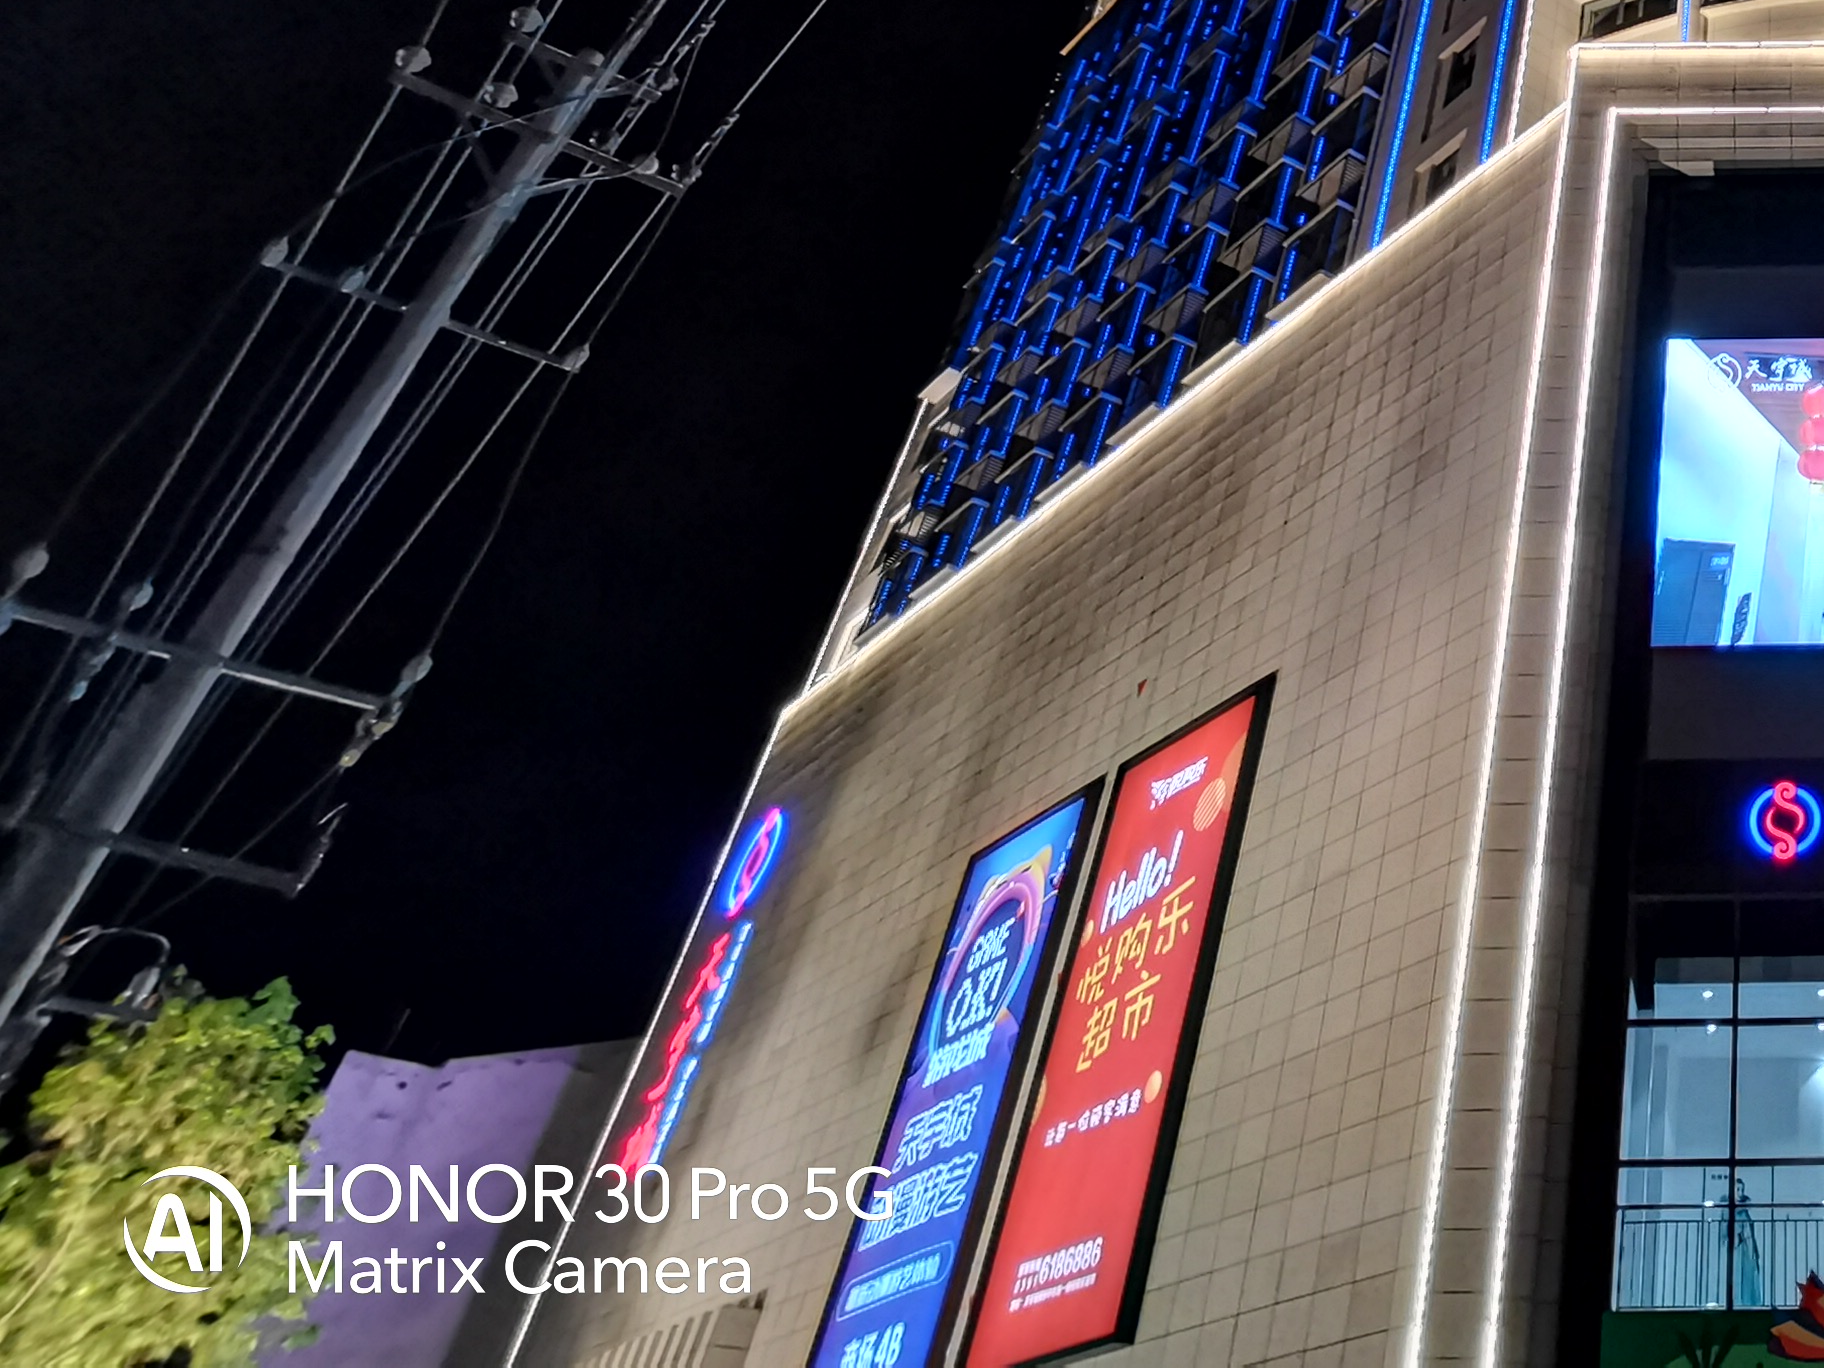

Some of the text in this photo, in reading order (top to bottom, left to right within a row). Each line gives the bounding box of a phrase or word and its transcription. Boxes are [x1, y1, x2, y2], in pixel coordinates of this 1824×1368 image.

[1100, 830, 1184, 934] Hello!
[966, 917, 1016, 973] GAME
[1075, 875, 1197, 1005] 悦购乐
[945, 957, 1008, 1037] OK!
[1075, 969, 1162, 1074] 超市
[892, 1084, 983, 1174] 天宇城
